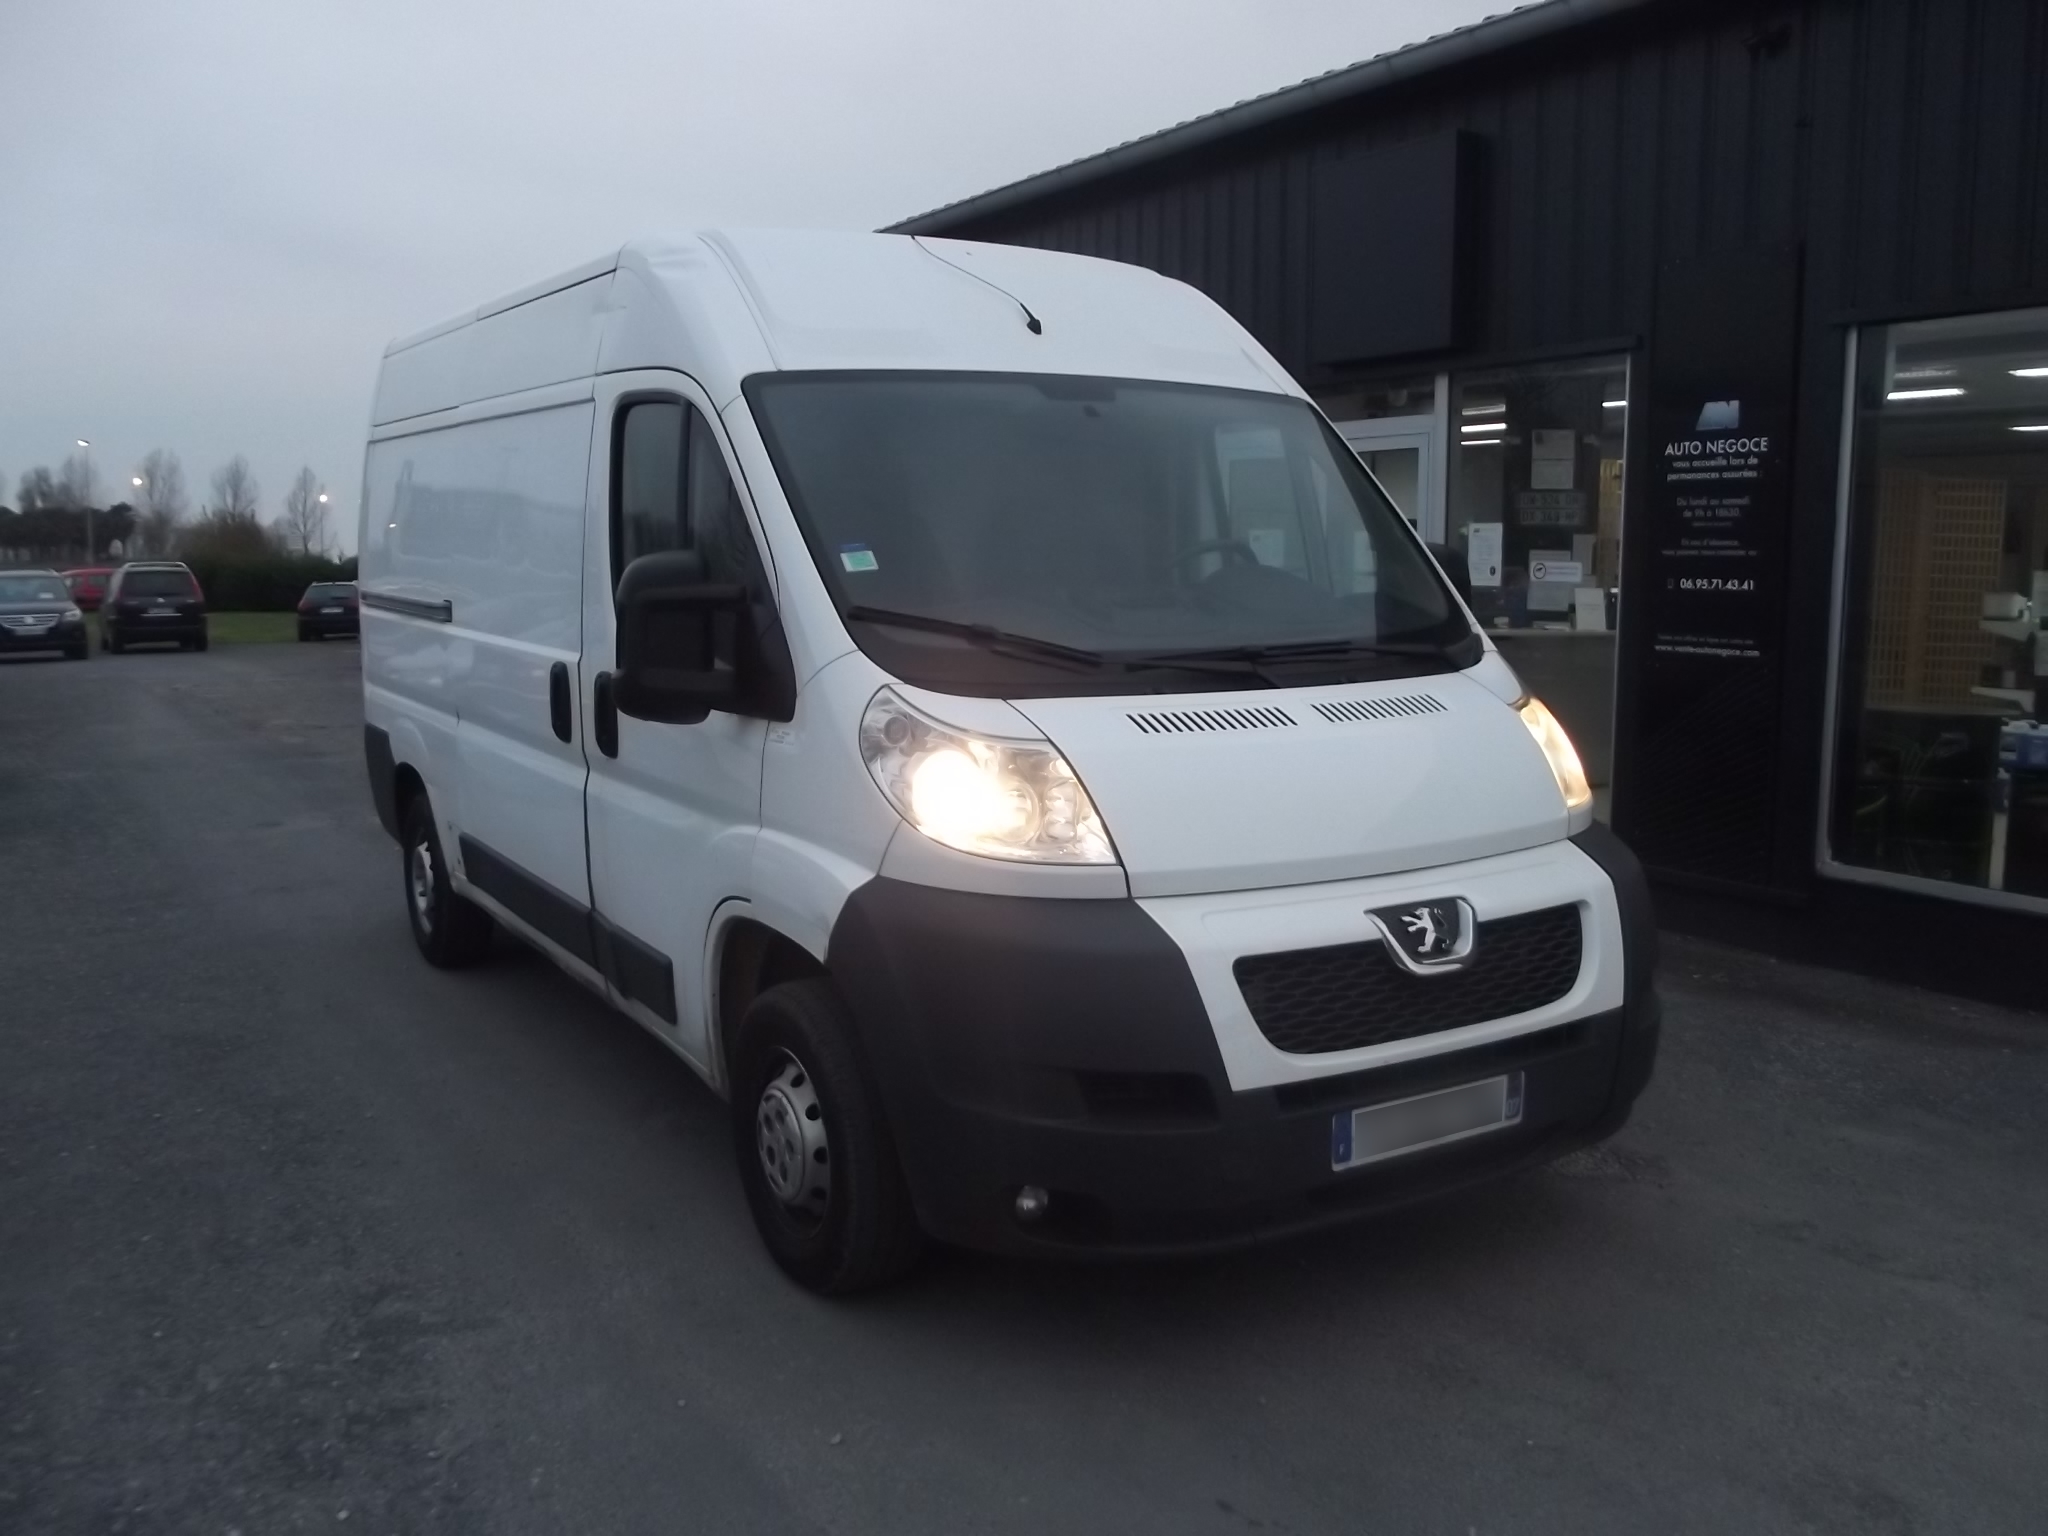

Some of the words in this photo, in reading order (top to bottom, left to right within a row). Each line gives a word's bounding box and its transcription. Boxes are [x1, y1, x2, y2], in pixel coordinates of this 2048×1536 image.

[1664, 440, 1702, 456] AUTO
[1705, 437, 1769, 454] NEGOCE
[1680, 578, 1754, 591] 06.95.71.43.41
